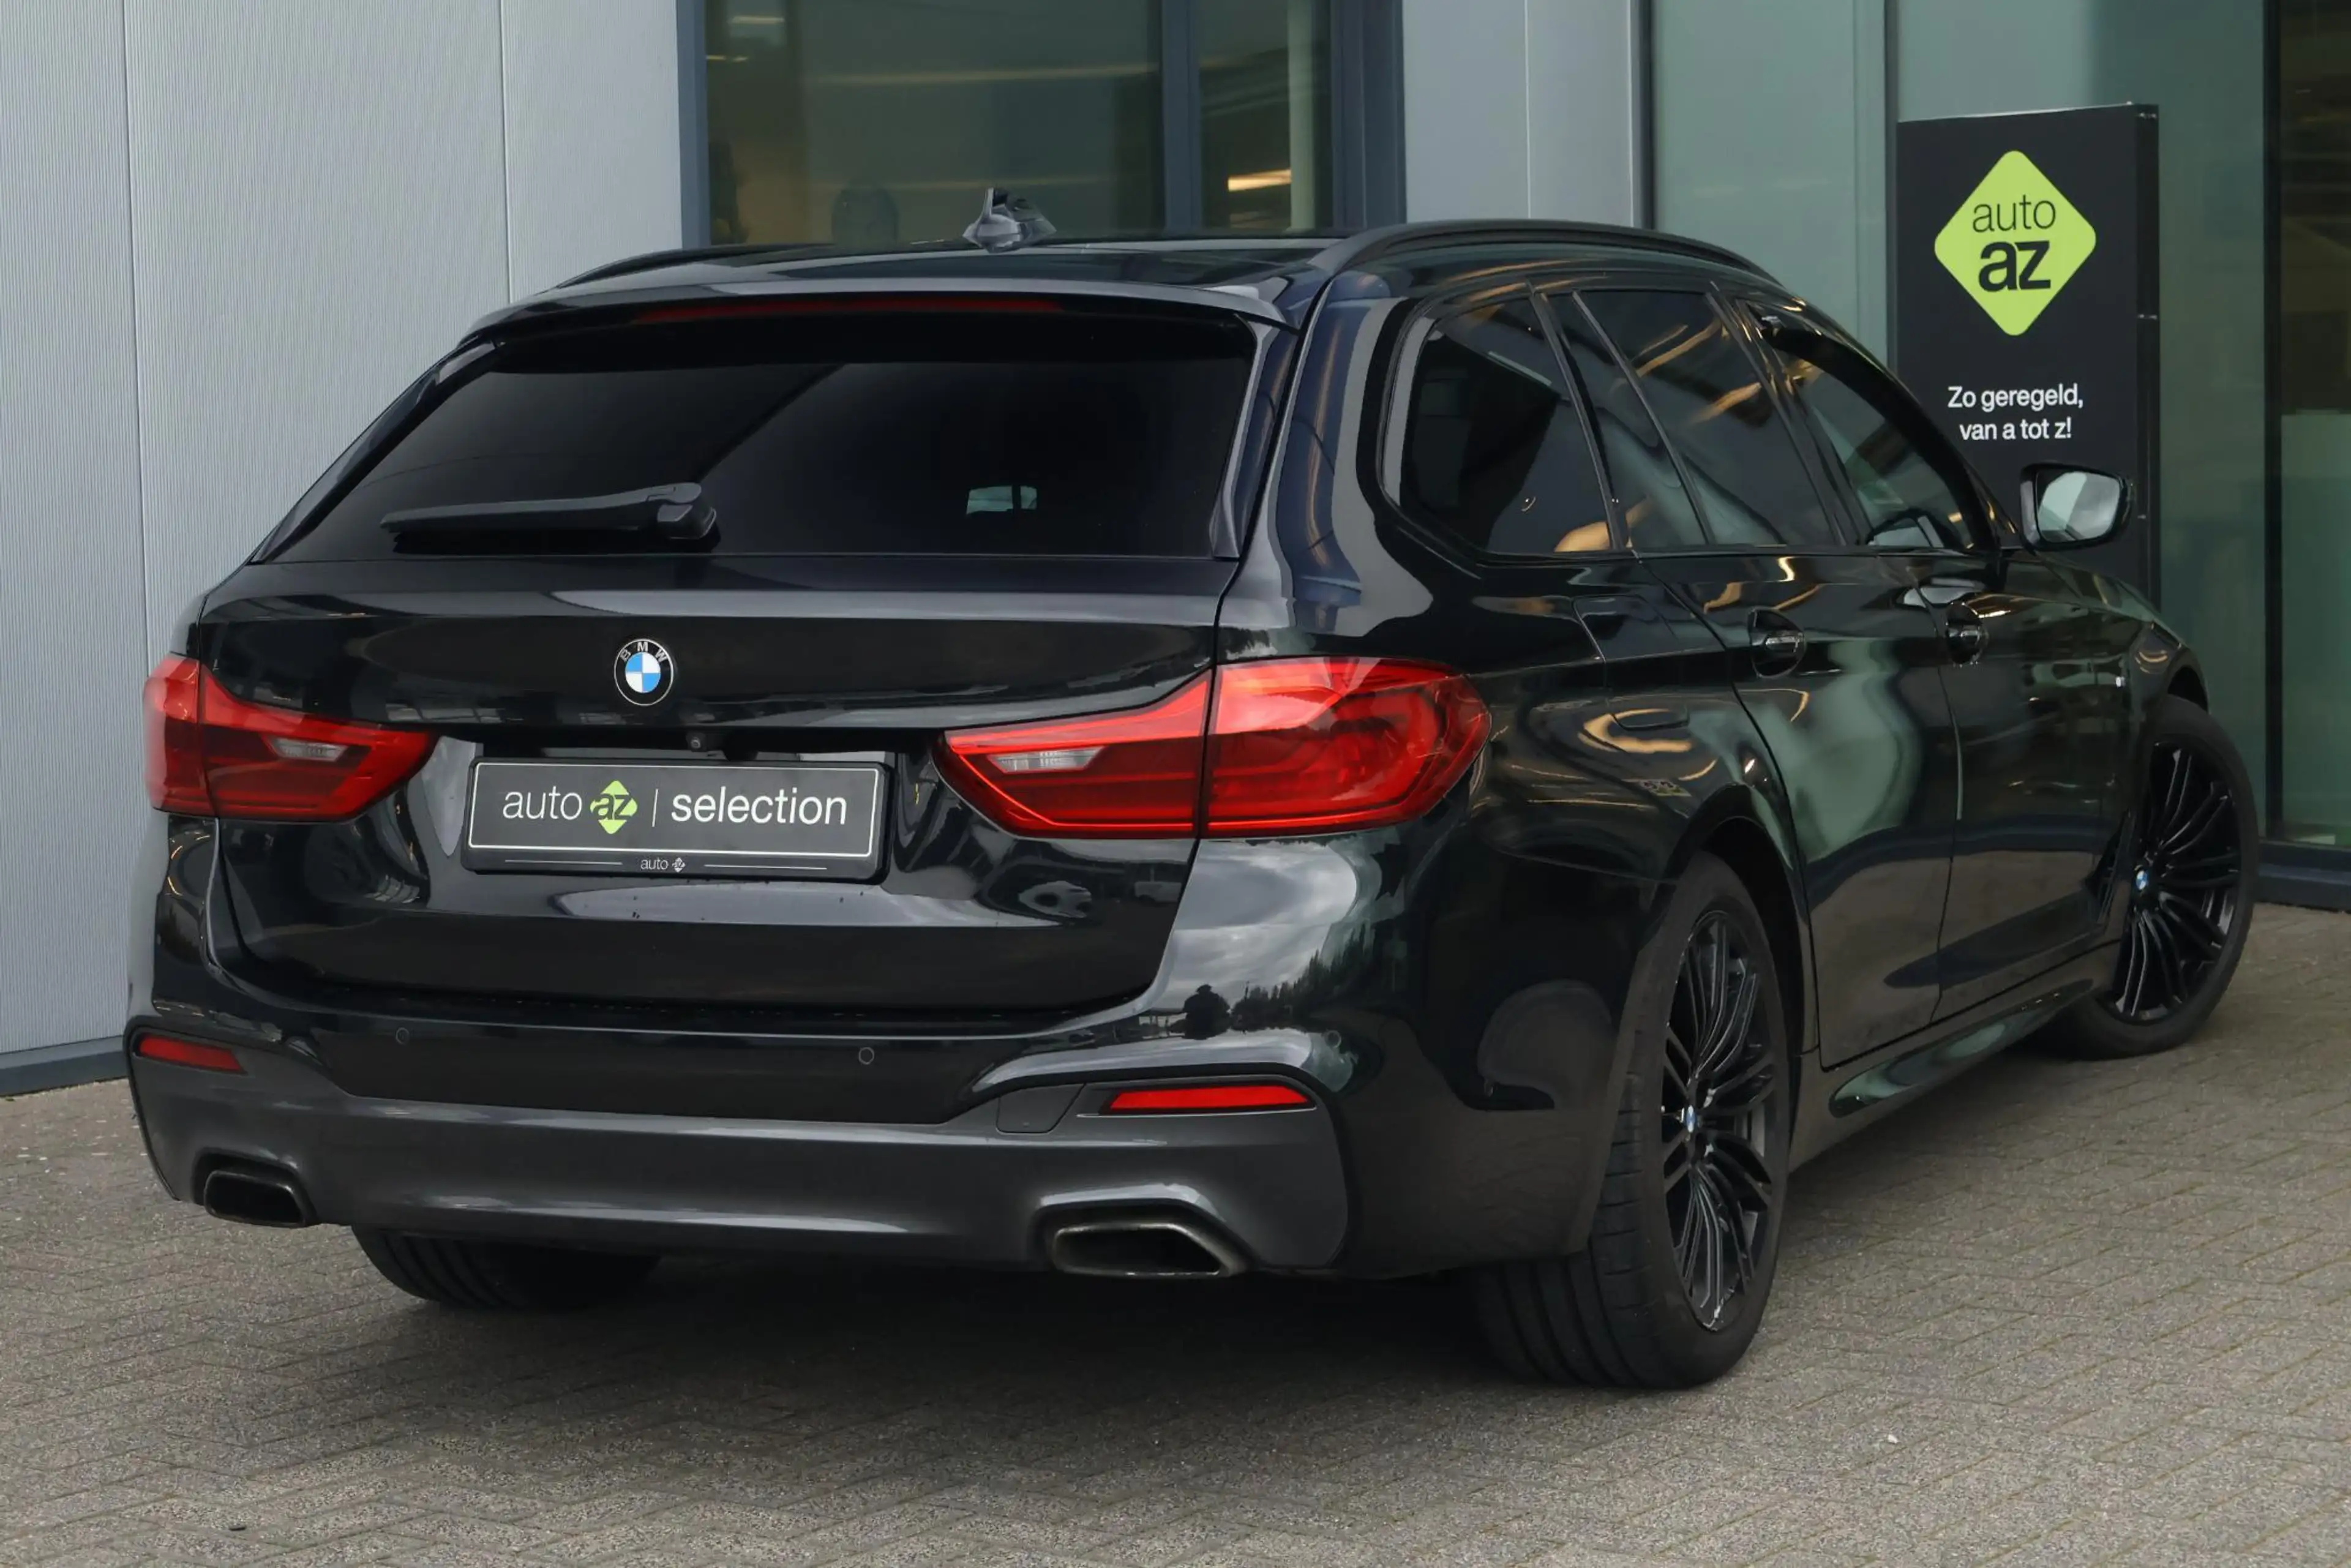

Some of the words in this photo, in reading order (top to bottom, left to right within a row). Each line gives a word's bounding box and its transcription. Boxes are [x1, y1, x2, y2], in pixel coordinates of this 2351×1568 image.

[1972, 194, 2056, 233] auto
[1978, 240, 2052, 293] az
[1948, 386, 1977, 408] Zo
[1981, 383, 2083, 413] geregeld,
[1959, 423, 1997, 440] van
[2001, 422, 2016, 440] a
[2020, 418, 2050, 440] tot
[2054, 416, 2072, 439] z!
[620, 641, 669, 662] BMW
[502, 786, 583, 820] auto
[590, 792, 634, 822] az
[671, 786, 847, 825] selection
[640, 857, 669, 870] auto
